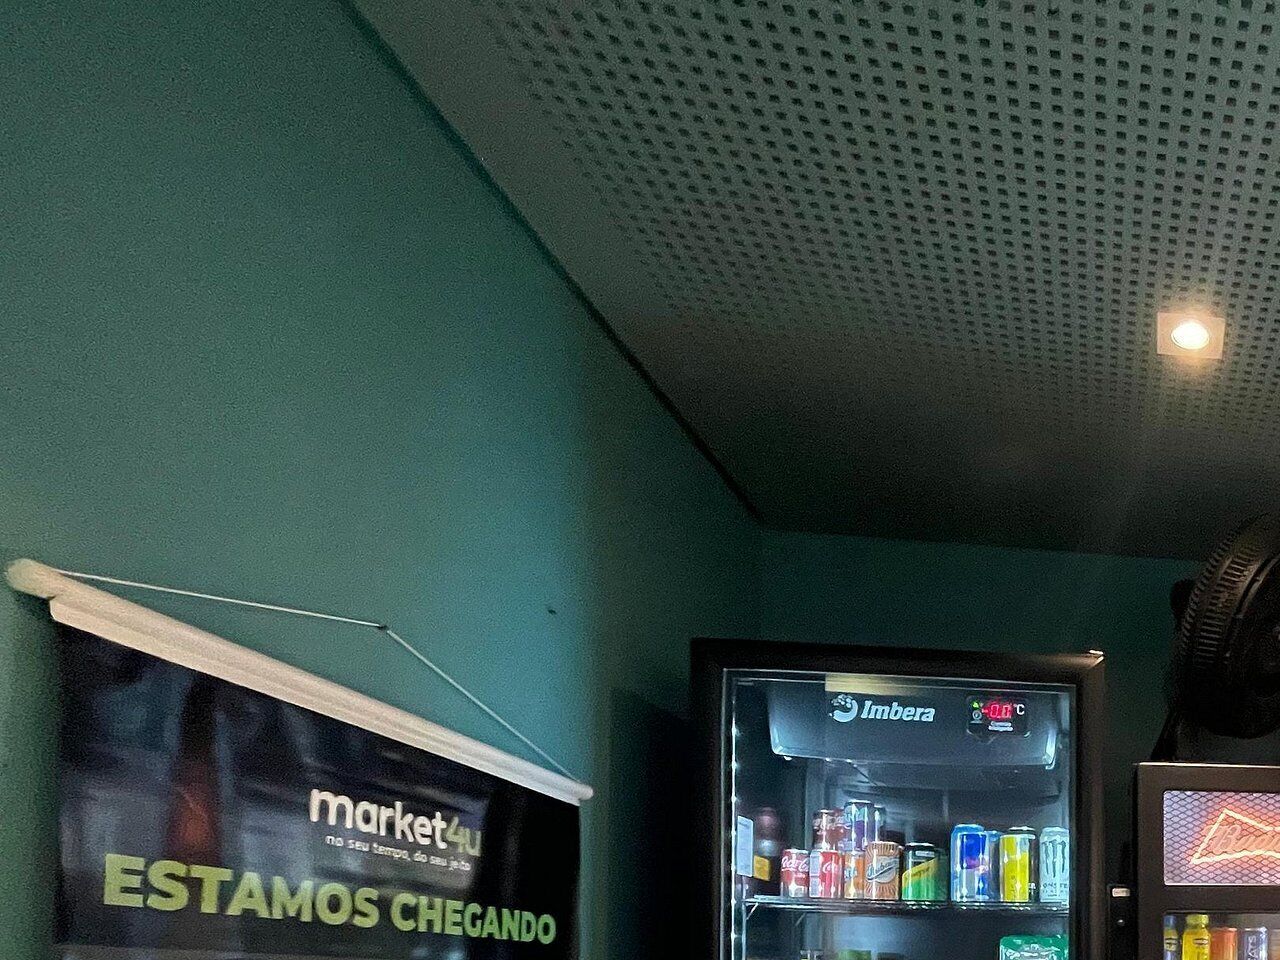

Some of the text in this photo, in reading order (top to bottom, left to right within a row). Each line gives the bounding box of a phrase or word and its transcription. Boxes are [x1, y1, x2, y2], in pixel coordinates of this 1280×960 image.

[860, 700, 936, 722] Imbera
[309, 788, 482, 857] market4u
[325, 835, 344, 847] no
[348, 838, 370, 852] seu
[413, 850, 428, 863] do
[430, 856, 447, 867] seu
[103, 853, 556, 945] ESTAMOS CHEGANDO
